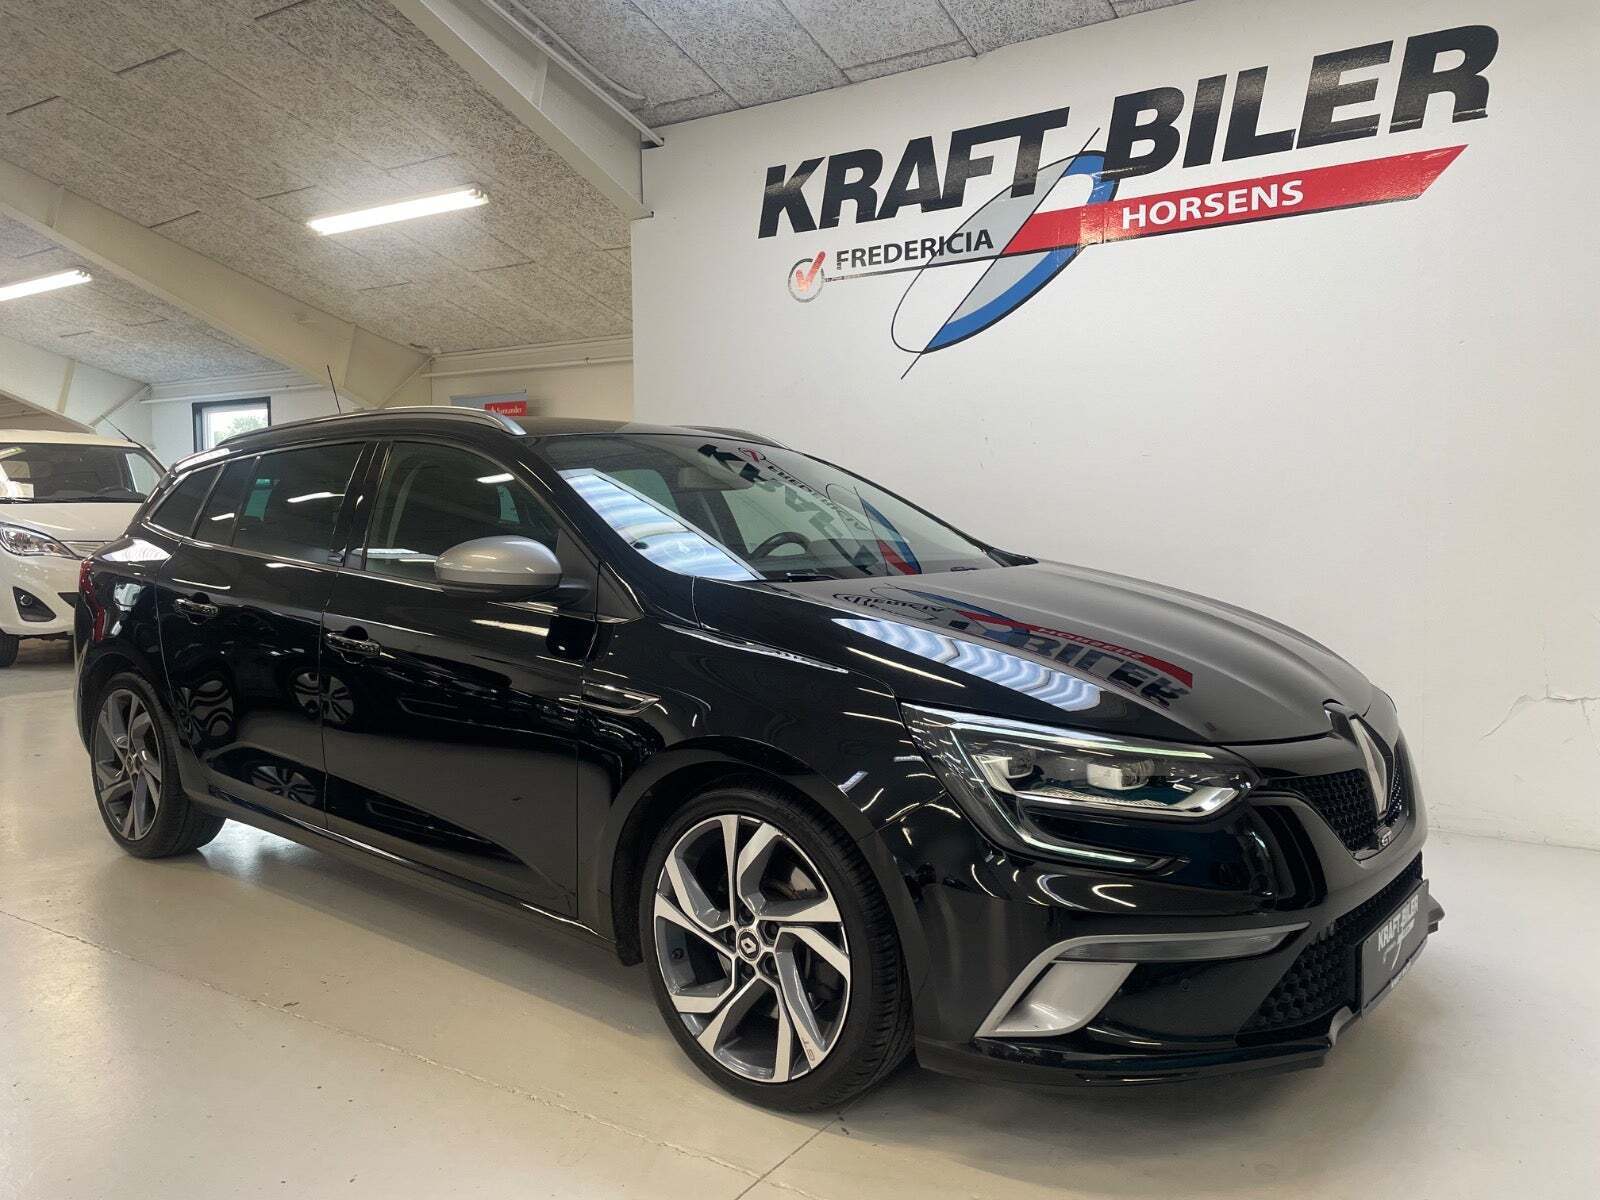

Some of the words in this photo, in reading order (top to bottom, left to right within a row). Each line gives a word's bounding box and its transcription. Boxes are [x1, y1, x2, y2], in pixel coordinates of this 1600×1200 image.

[757, 106, 1069, 239] KRAFT
[1102, 25, 1500, 182] BILER
[1121, 180, 1305, 231] HORSENS
[836, 229, 994, 271] FREDERICIA
